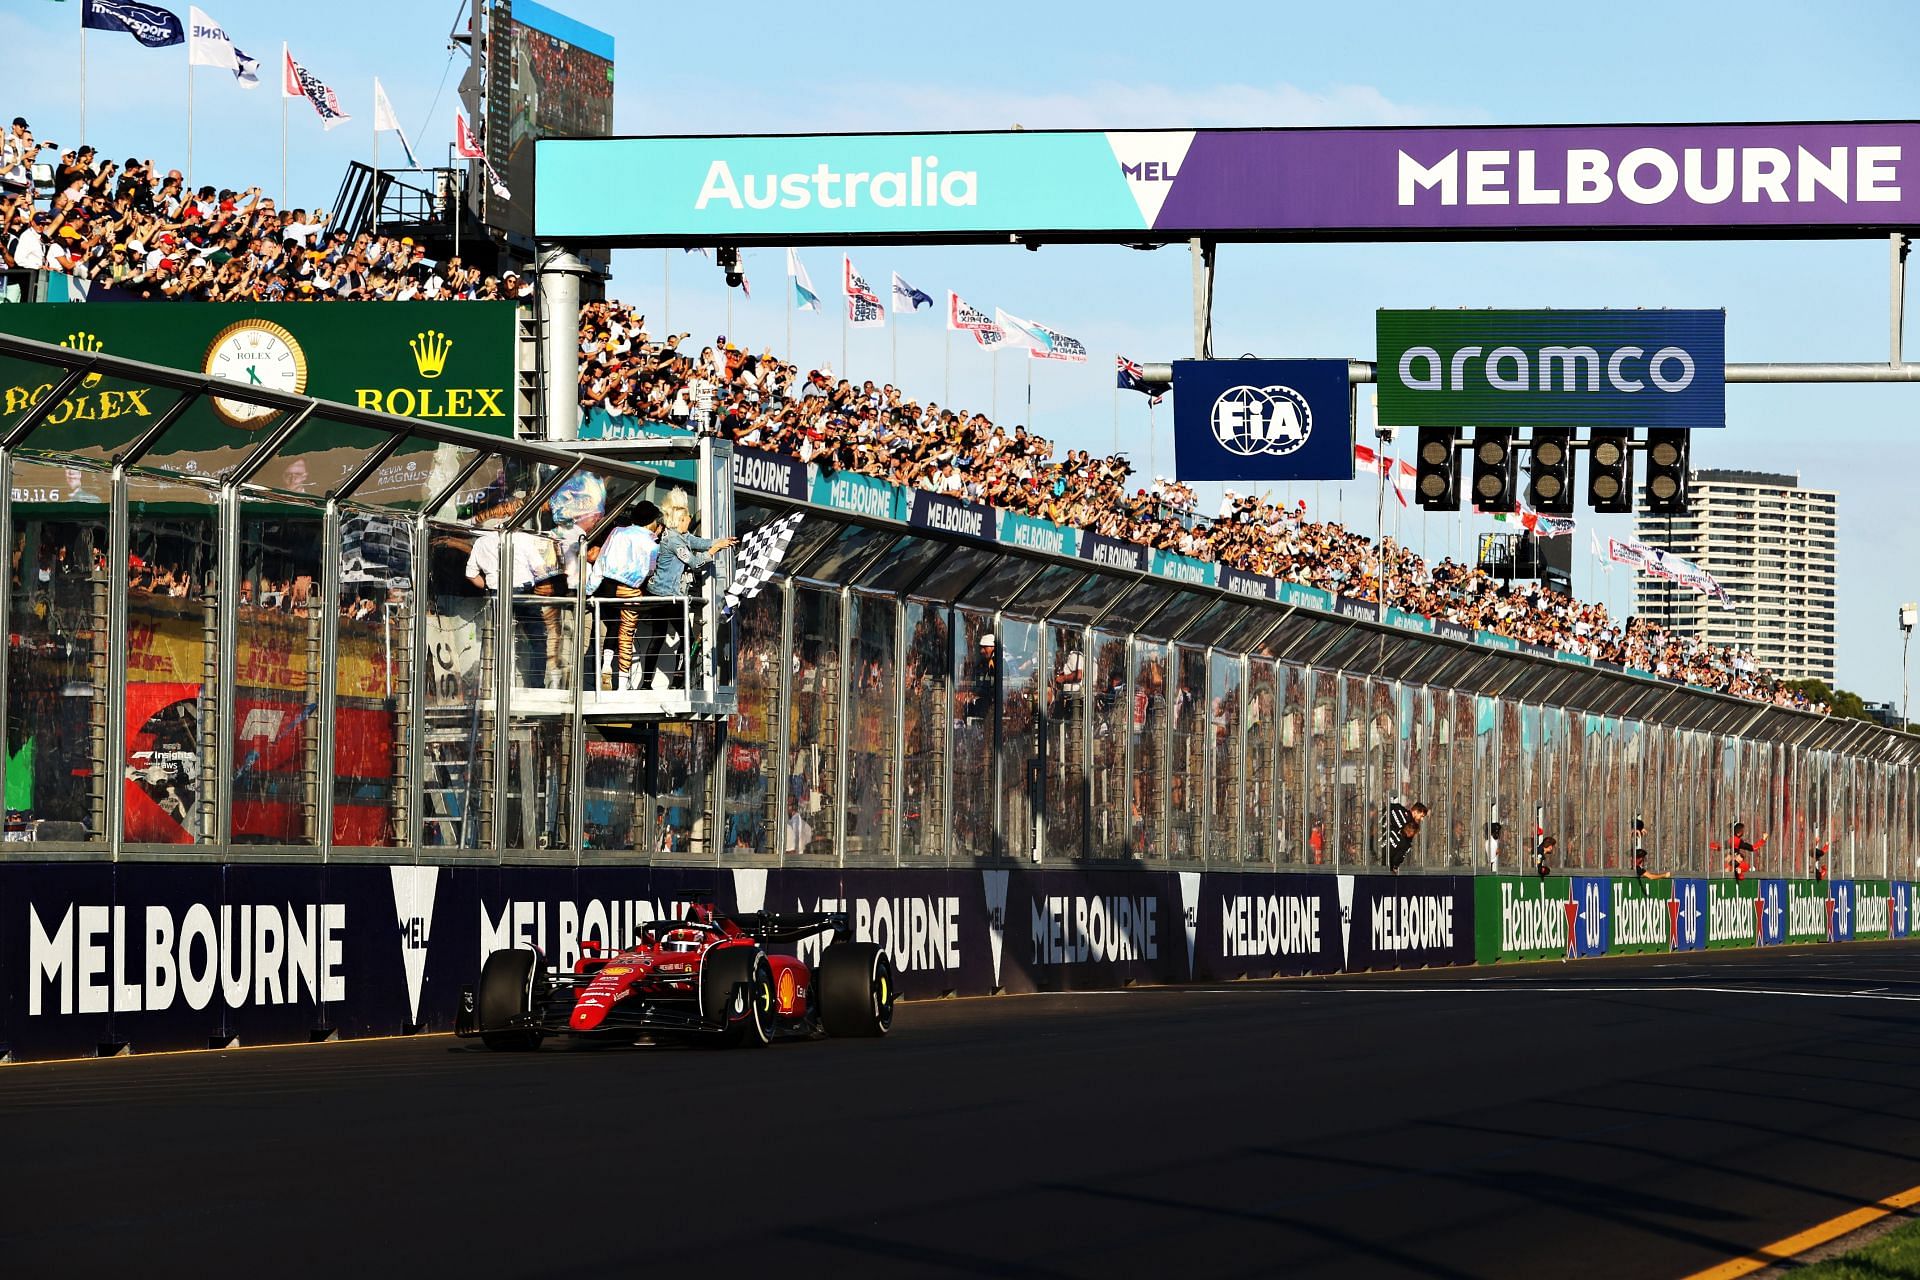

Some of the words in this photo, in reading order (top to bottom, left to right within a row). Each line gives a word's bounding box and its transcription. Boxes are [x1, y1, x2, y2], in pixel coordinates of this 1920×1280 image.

[694, 155, 977, 209] Australia
[1121, 161, 1177, 182] MEL
[1398, 144, 1902, 206] MELBOURNE
[237, 352, 272, 360] ROLEX
[1399, 345, 1696, 393] aramco
[355, 388, 506, 417] ROLEX
[733, 452, 791, 496] ELBOURNE
[830, 479, 890, 517] MELBOURNE
[927, 501, 982, 537] MELBOURNE
[1015, 522, 1064, 554] MELBOURNE
[155, 751, 193, 761] Insights
[1032, 894, 1158, 965] MELBOURNE
[1222, 894, 1321, 957] MELBOURNE
[1371, 895, 1454, 951] MELBOURNE
[1501, 882, 1565, 951] Heineken
[1613, 882, 1667, 945] Heineken
[1709, 883, 1754, 941] Heineken
[1789, 883, 1826, 936] Heineken
[1855, 884, 1888, 933] Heineken
[400, 917, 428, 950] MEL
[29, 901, 346, 1016] MELBOURNE
